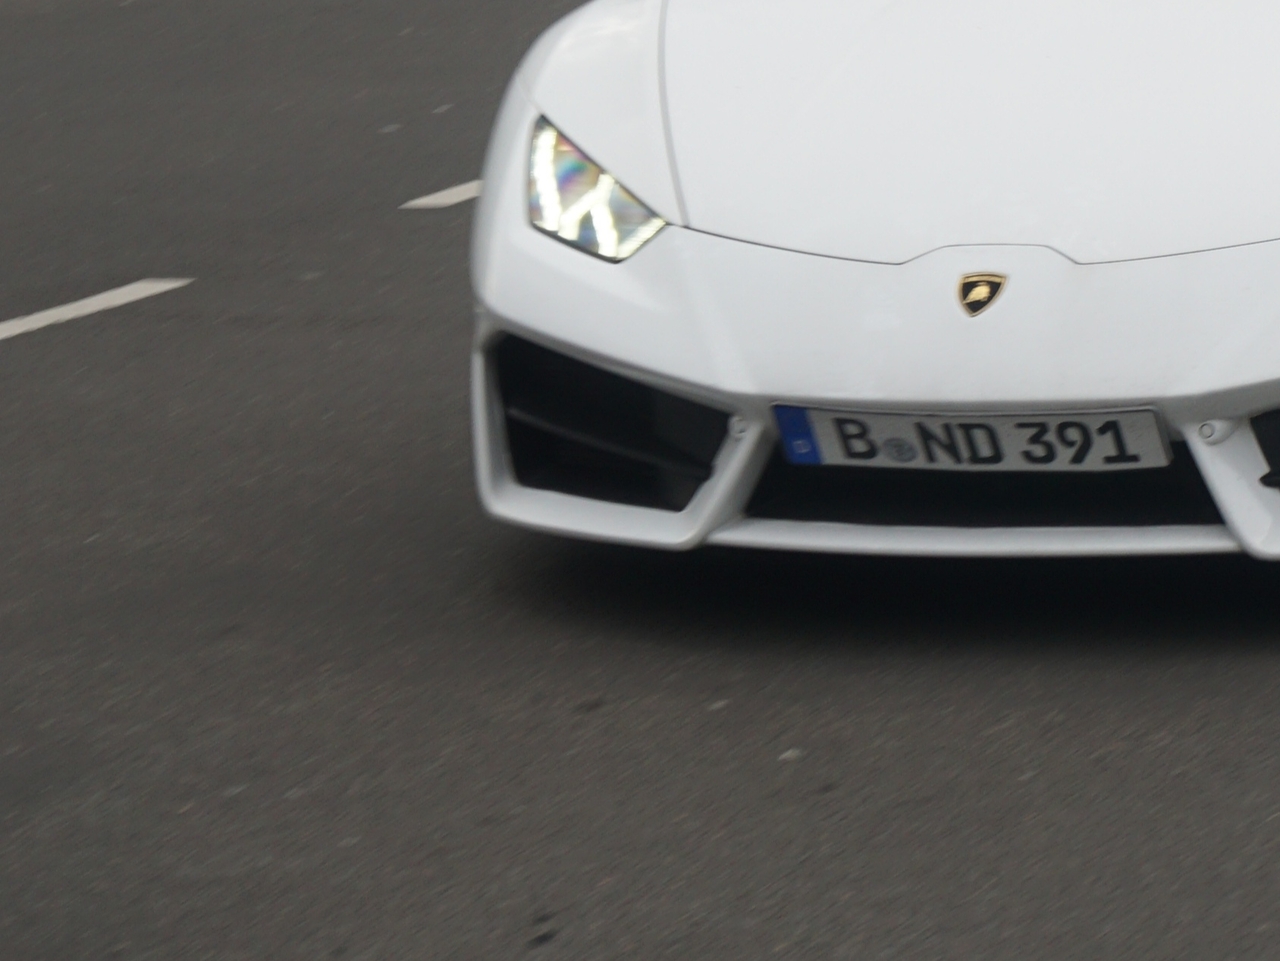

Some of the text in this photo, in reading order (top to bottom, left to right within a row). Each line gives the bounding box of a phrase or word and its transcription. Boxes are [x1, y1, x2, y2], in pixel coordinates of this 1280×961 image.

[832, 418, 879, 460] B
[915, 421, 1004, 465] ND
[1014, 419, 1140, 464] 391
